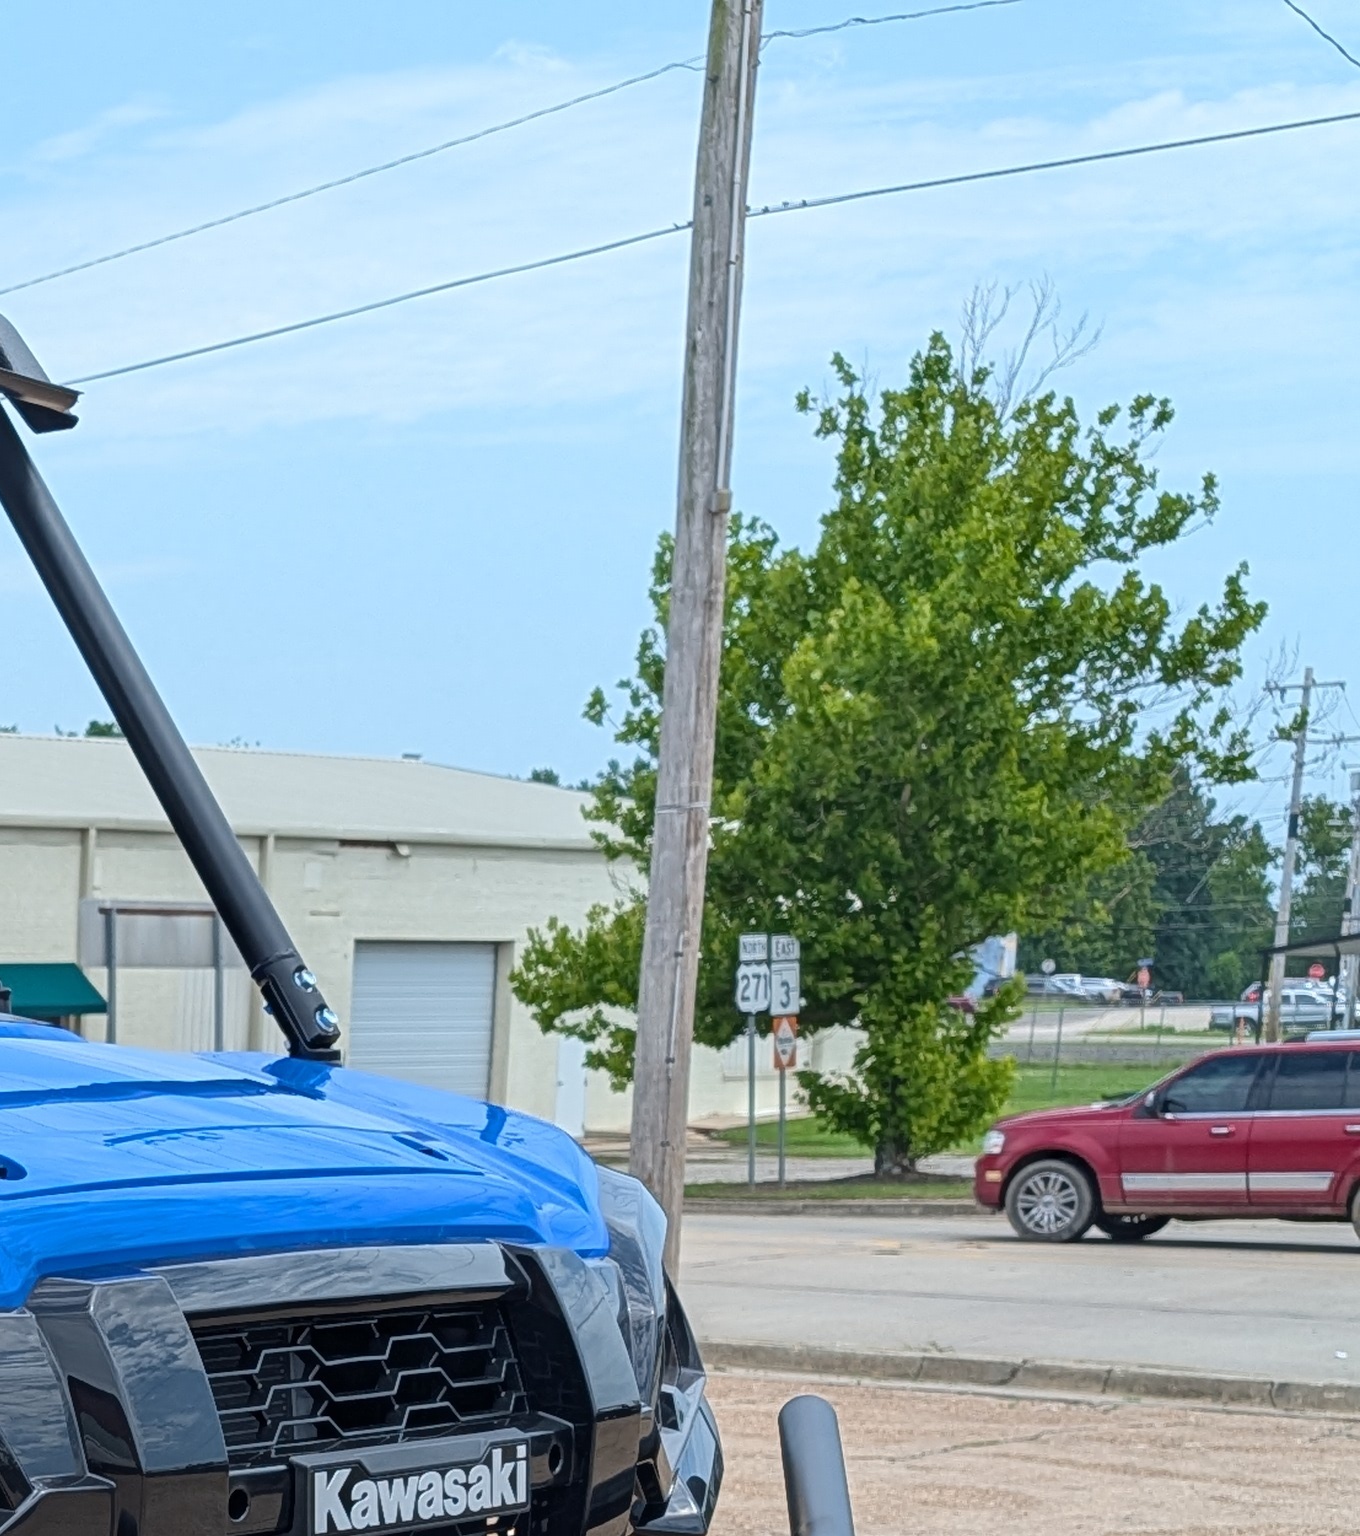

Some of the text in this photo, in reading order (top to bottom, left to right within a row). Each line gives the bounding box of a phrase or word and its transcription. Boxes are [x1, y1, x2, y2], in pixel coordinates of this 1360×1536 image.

[742, 942, 767, 955] NORTH
[775, 941, 796, 958] EAST
[740, 973, 768, 1002] 271
[780, 980, 791, 1009] 3
[313, 1444, 528, 1535] Kawasaki
